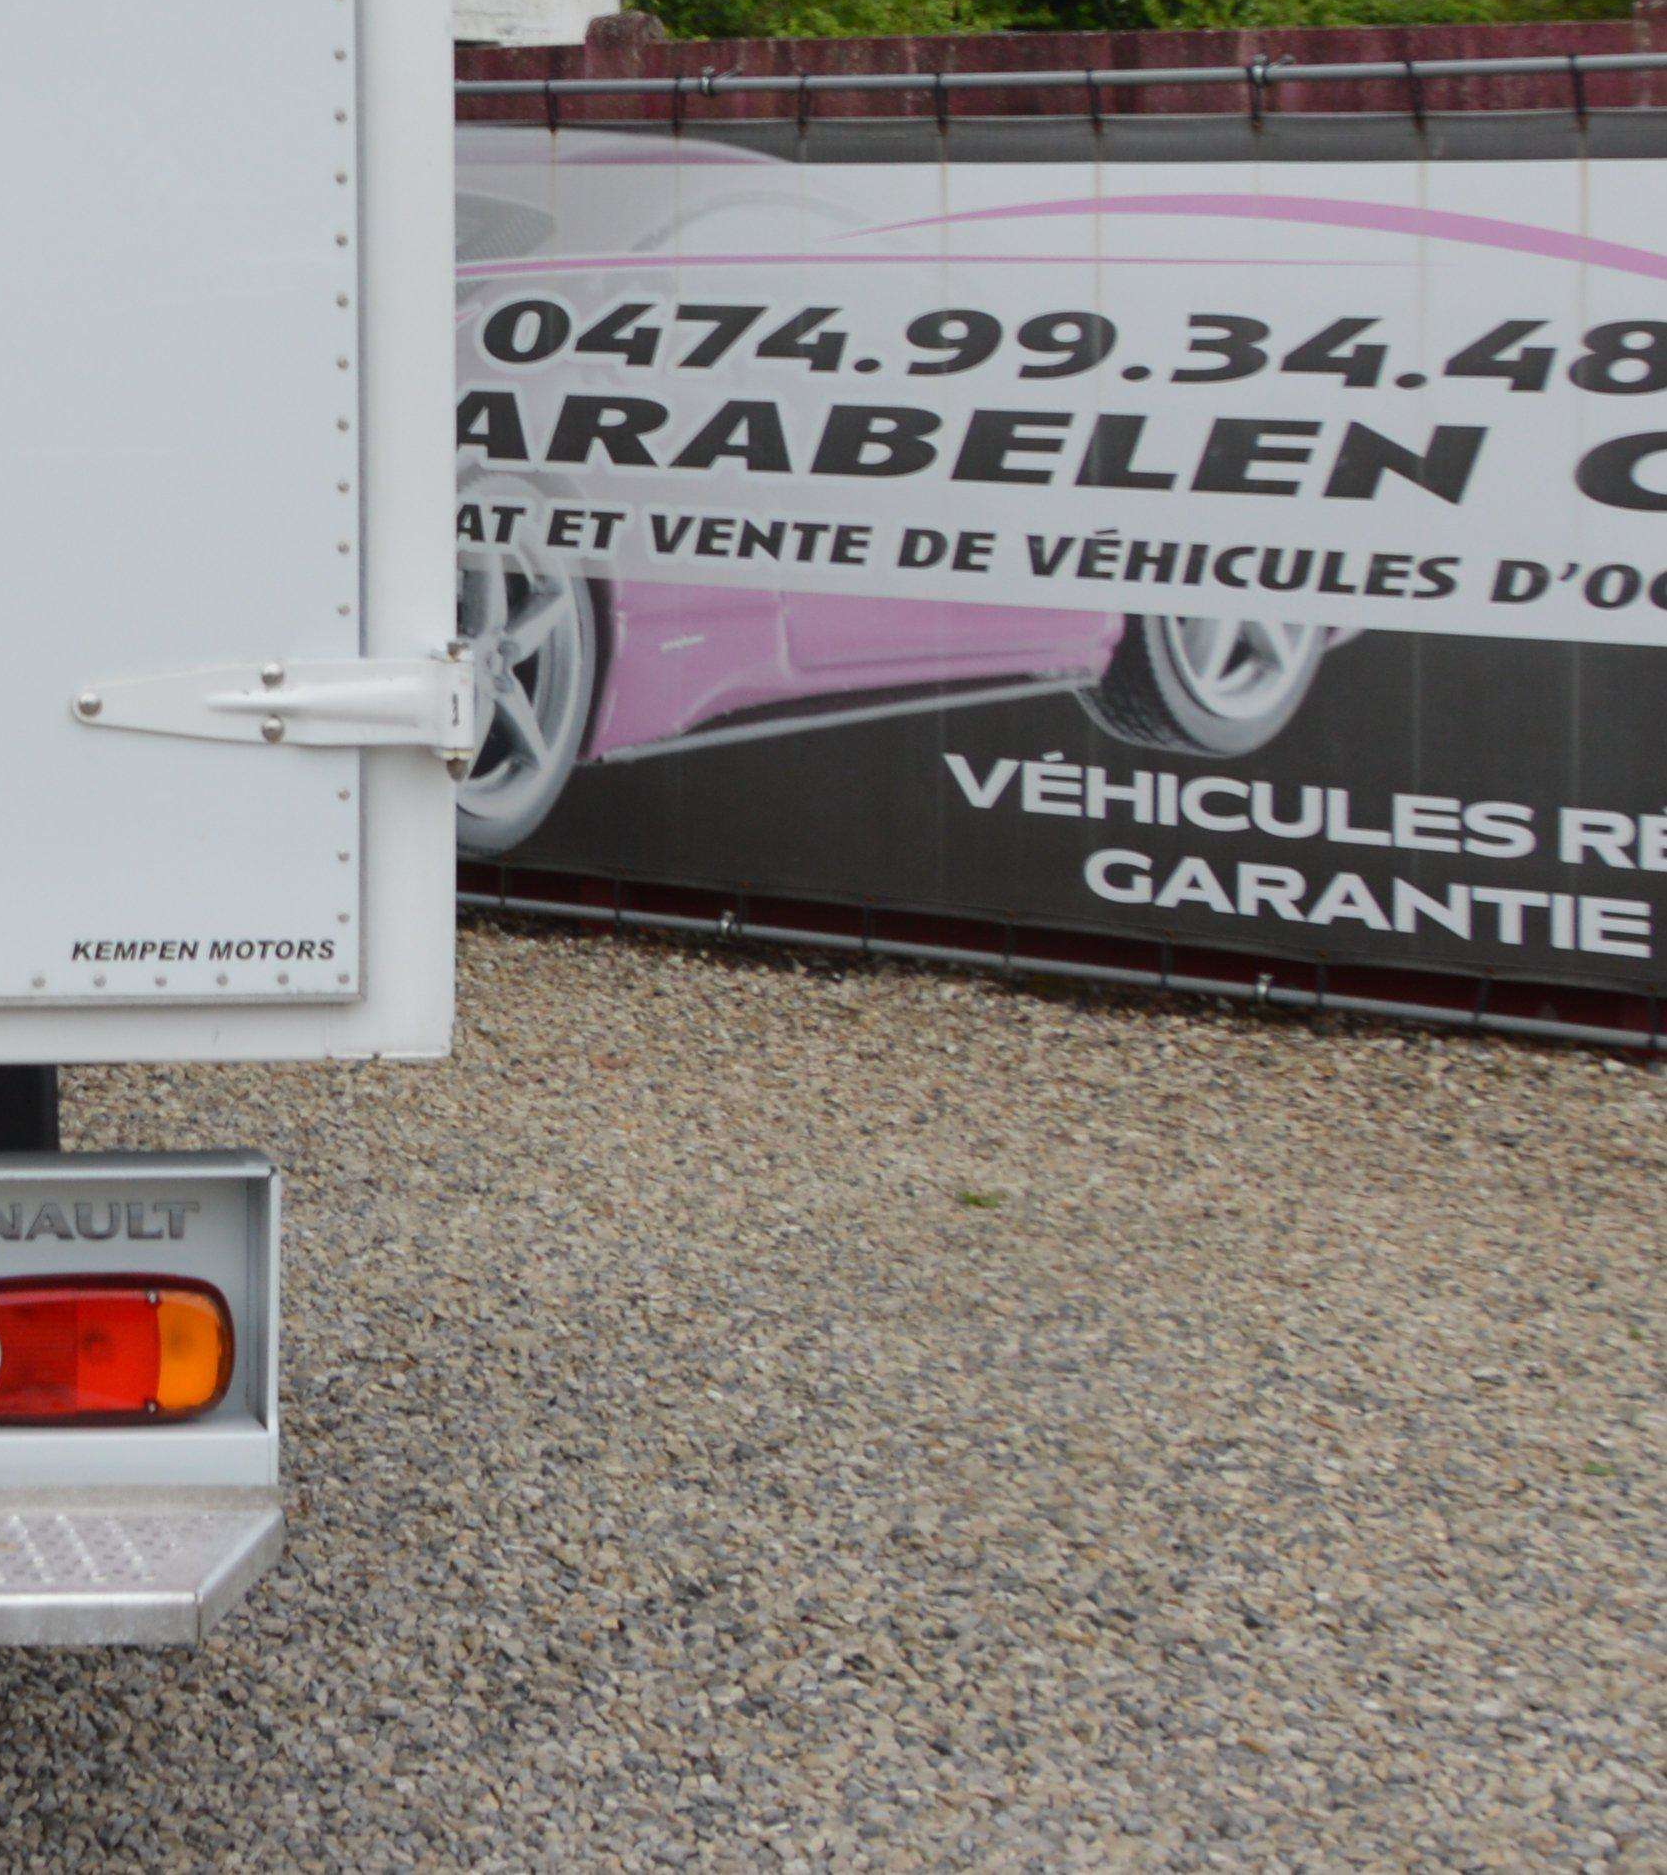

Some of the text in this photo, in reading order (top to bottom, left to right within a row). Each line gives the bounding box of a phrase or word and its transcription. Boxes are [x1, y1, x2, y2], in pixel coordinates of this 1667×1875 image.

[482, 299, 1667, 396] 0474.99.34.48
[546, 508, 626, 550] ET
[650, 514, 872, 566] VENTE
[896, 528, 996, 573] DE
[1026, 529, 1461, 599] VÉHICULES
[943, 751, 1536, 859] VÉHICULES
[71, 939, 336, 961] KEMPEN MOTORS
[1084, 848, 1653, 959] GARANTIE
